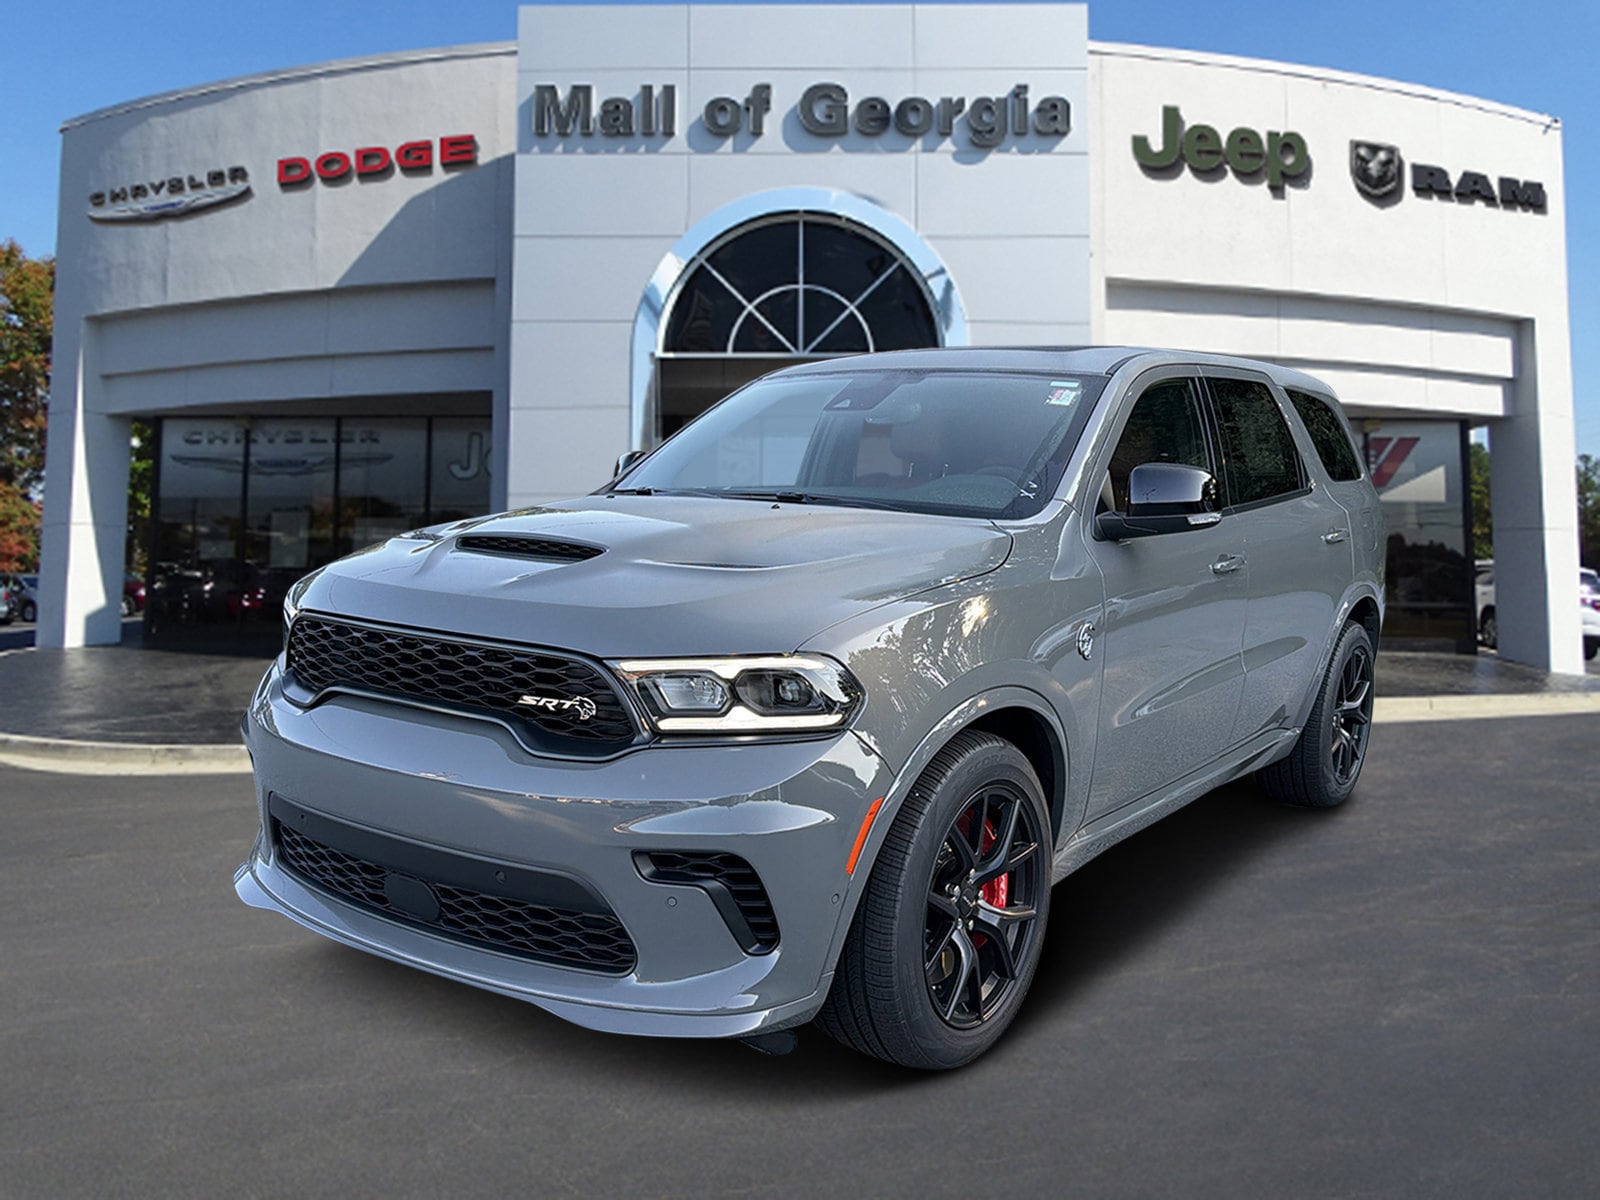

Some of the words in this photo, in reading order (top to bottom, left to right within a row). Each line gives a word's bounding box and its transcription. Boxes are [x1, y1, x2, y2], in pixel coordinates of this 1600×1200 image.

[533, 84, 676, 137] Mall
[703, 83, 772, 136] of
[799, 83, 1072, 147] Georgia
[277, 134, 478, 190] DODGE
[1131, 105, 1311, 200] Jeep
[89, 166, 249, 208] CHRYSLER
[1411, 163, 1548, 214] RAM
[517, 695, 579, 711] SRT
